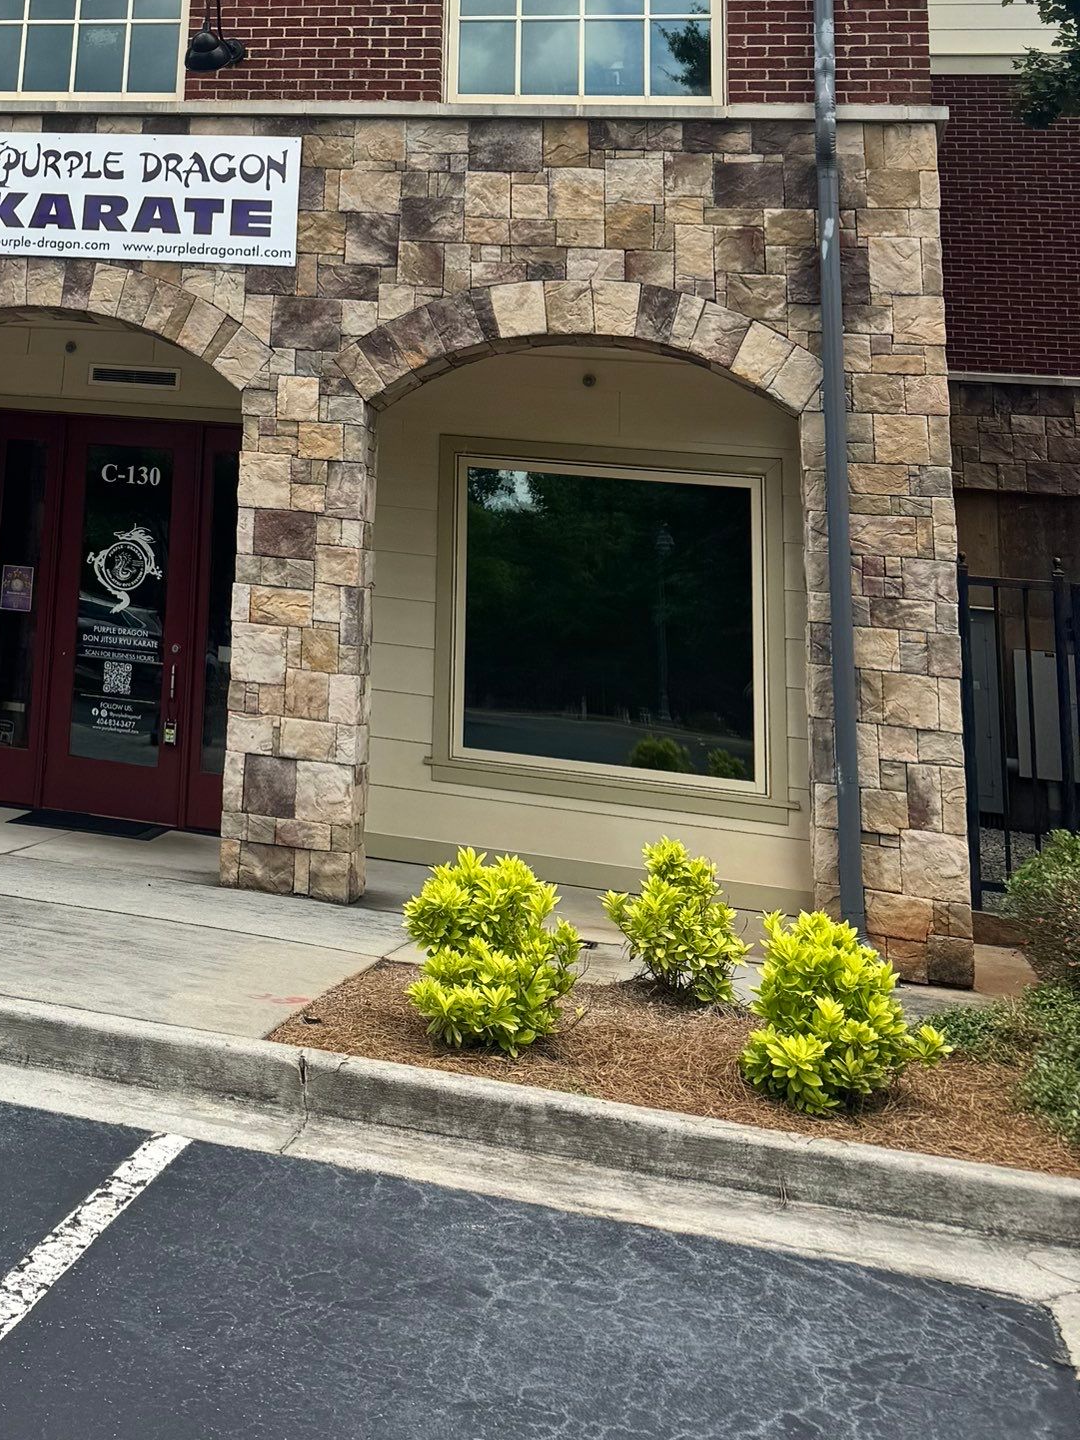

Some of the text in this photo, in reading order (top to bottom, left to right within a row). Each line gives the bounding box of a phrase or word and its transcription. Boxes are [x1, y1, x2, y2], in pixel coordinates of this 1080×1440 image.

[139, 149, 288, 191] DRAGON
[122, 241, 292, 259] www.purpledragonatl.com
[101, 463, 161, 486] C-130
[93, 625, 149, 637] PURPLE DRAGON
[82, 634, 159, 649] DON JITSU RYU KARATE
[112, 651, 136, 660] BUSINESS
[100, 702, 123, 710] FOLLOW
